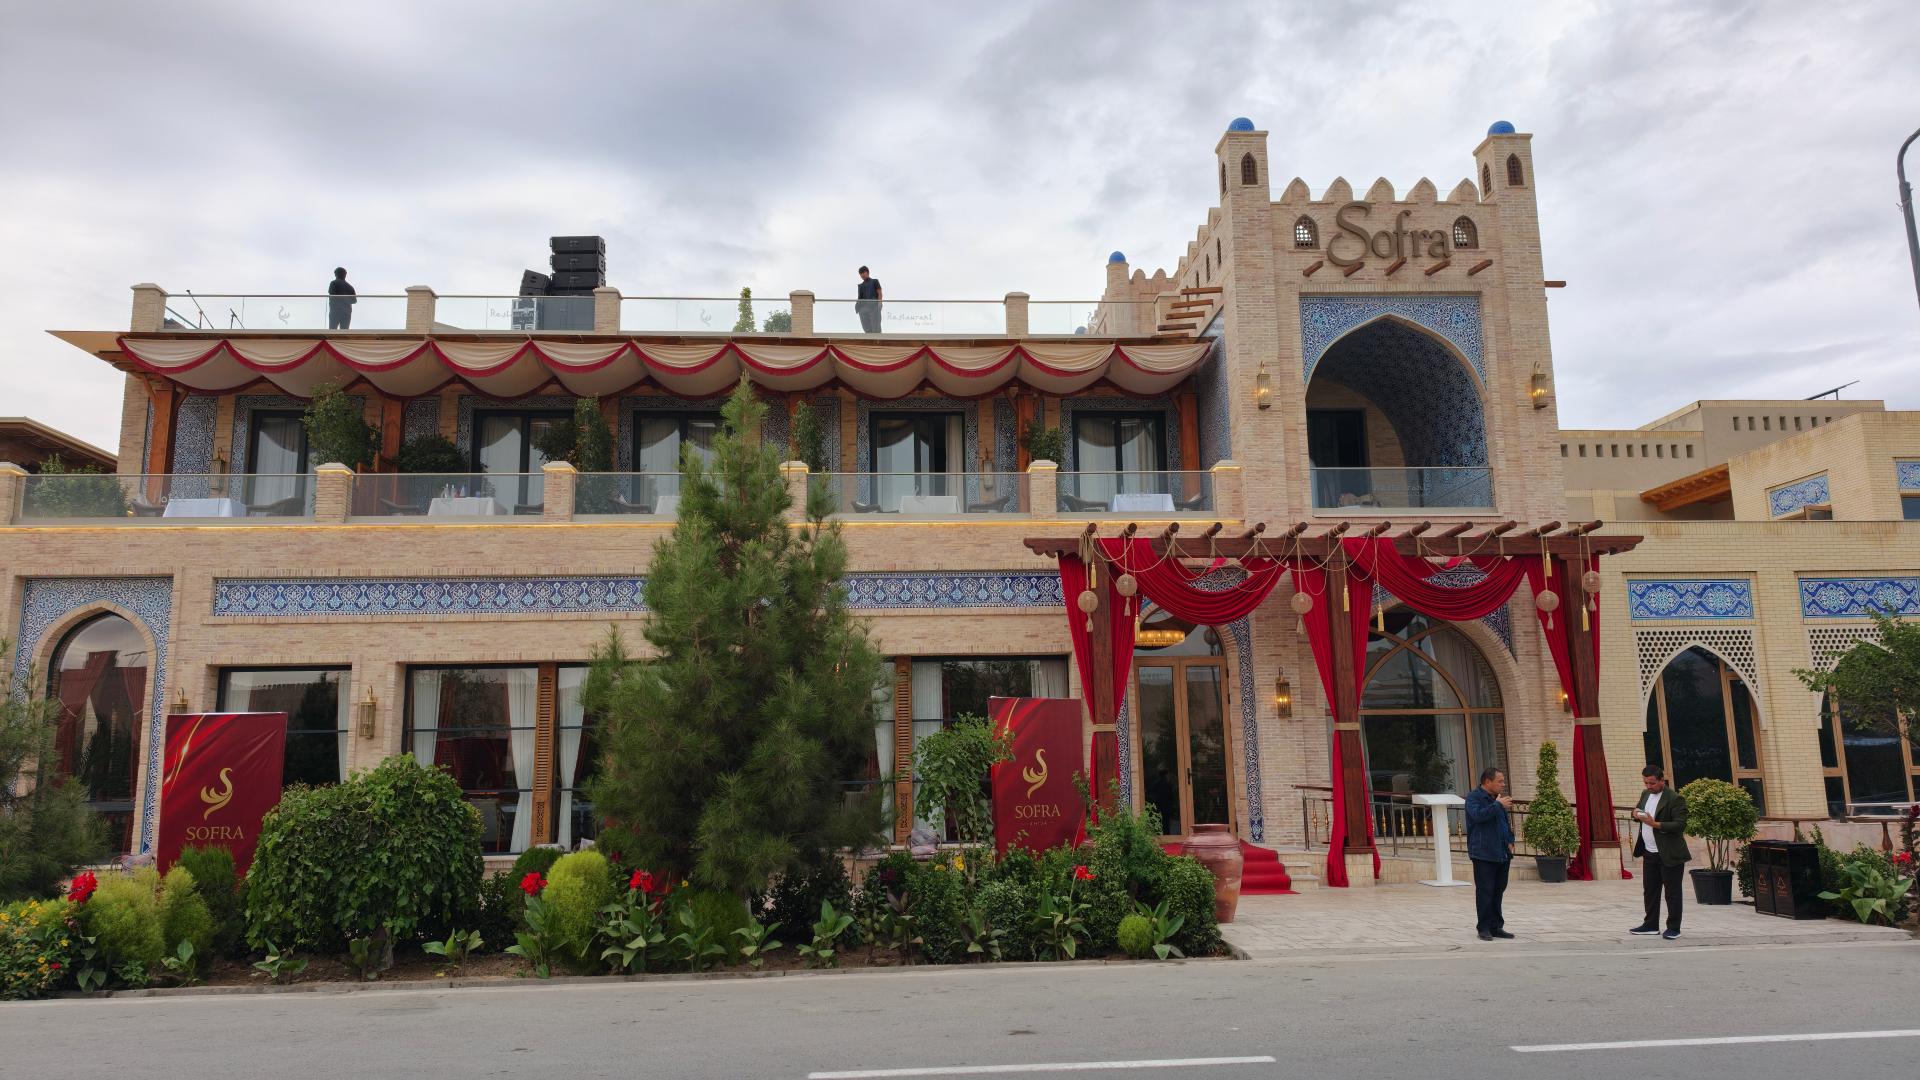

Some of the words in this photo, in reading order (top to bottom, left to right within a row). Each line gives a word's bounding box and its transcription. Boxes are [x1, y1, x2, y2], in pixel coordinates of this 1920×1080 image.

[1327, 201, 1452, 266] Sofra
[1015, 804, 1061, 819] SOFRA
[185, 826, 244, 840] SOFRA
